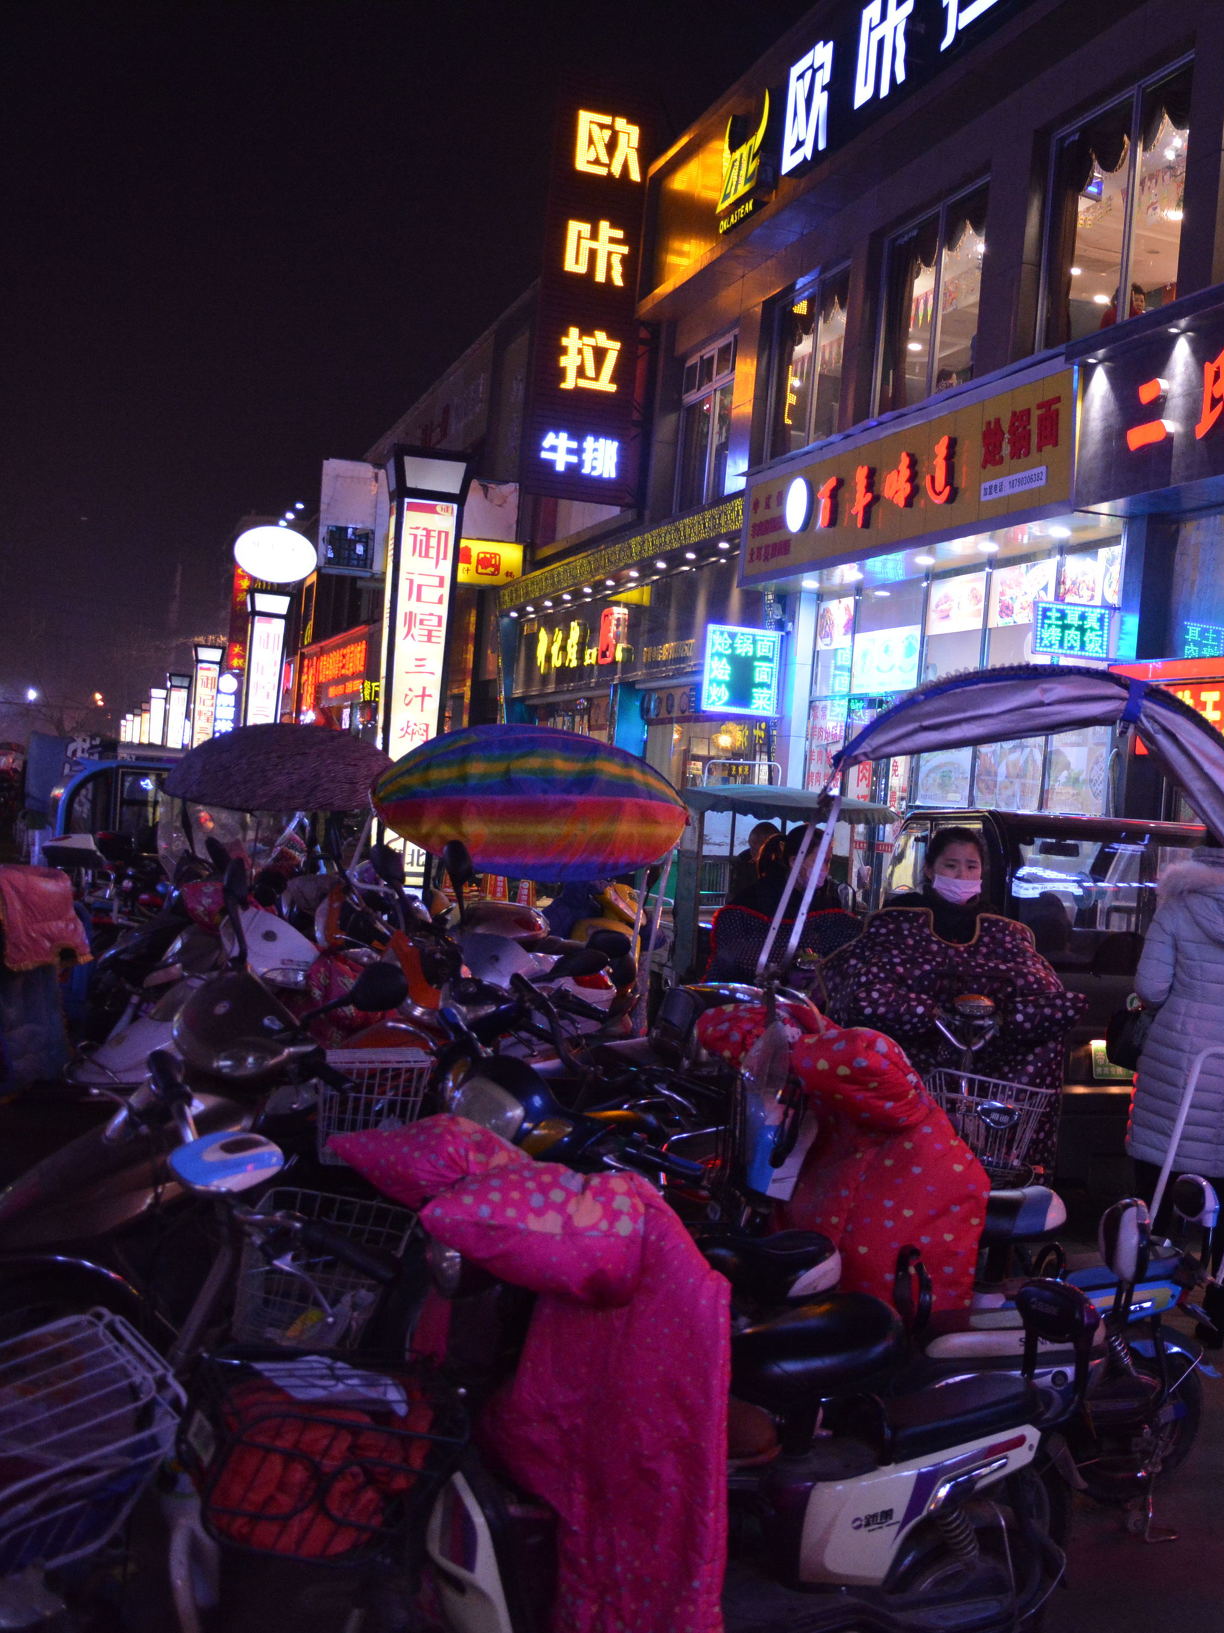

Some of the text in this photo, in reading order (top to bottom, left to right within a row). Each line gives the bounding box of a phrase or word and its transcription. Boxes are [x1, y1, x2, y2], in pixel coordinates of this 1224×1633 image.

[559, 110, 641, 392] 欧咔拉
[711, 630, 778, 658] 炝锅面
[1041, 624, 1103, 653] 烤肉饭
